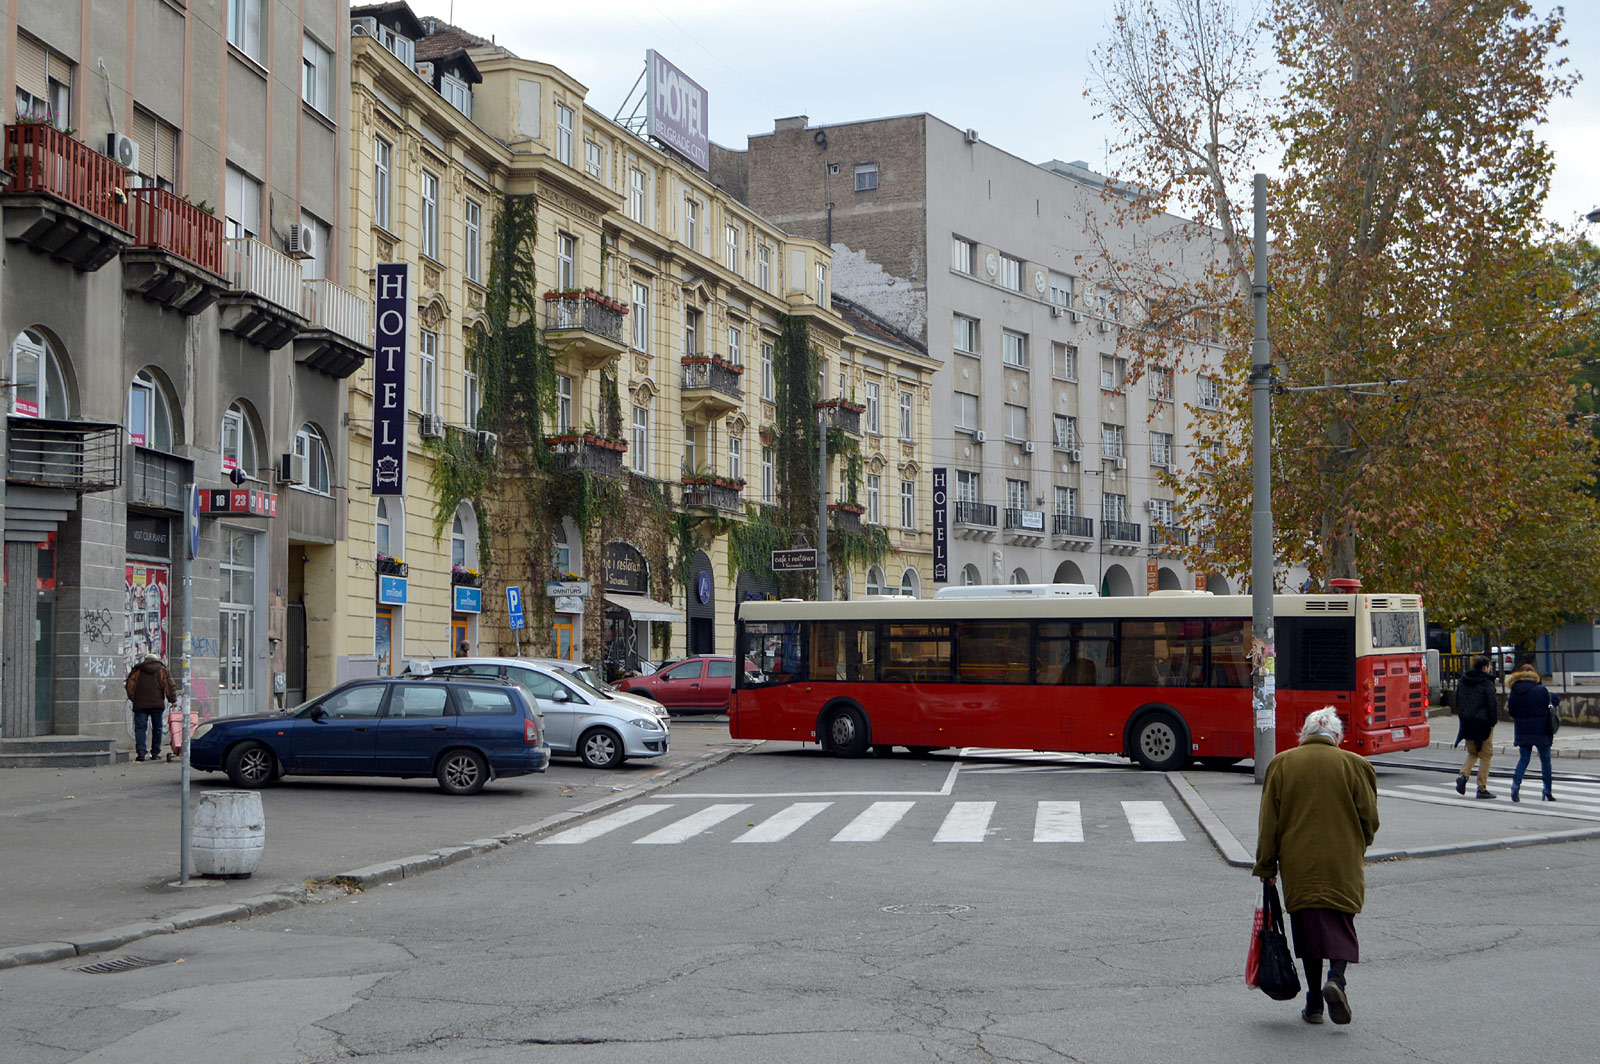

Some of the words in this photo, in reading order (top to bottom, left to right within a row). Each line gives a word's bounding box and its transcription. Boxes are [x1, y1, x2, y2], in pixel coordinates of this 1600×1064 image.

[655, 57, 706, 144] HOTEL
[655, 118, 691, 154] BELGRADE
[691, 144, 706, 163] CITY
[379, 274, 404, 446] HOTEL
[216, 494, 226, 507] 16
[235, 494, 247, 507] 23
[934, 473, 946, 559] HOTEL
[143, 532, 152, 541] OUR
[511, 589, 519, 607] P
